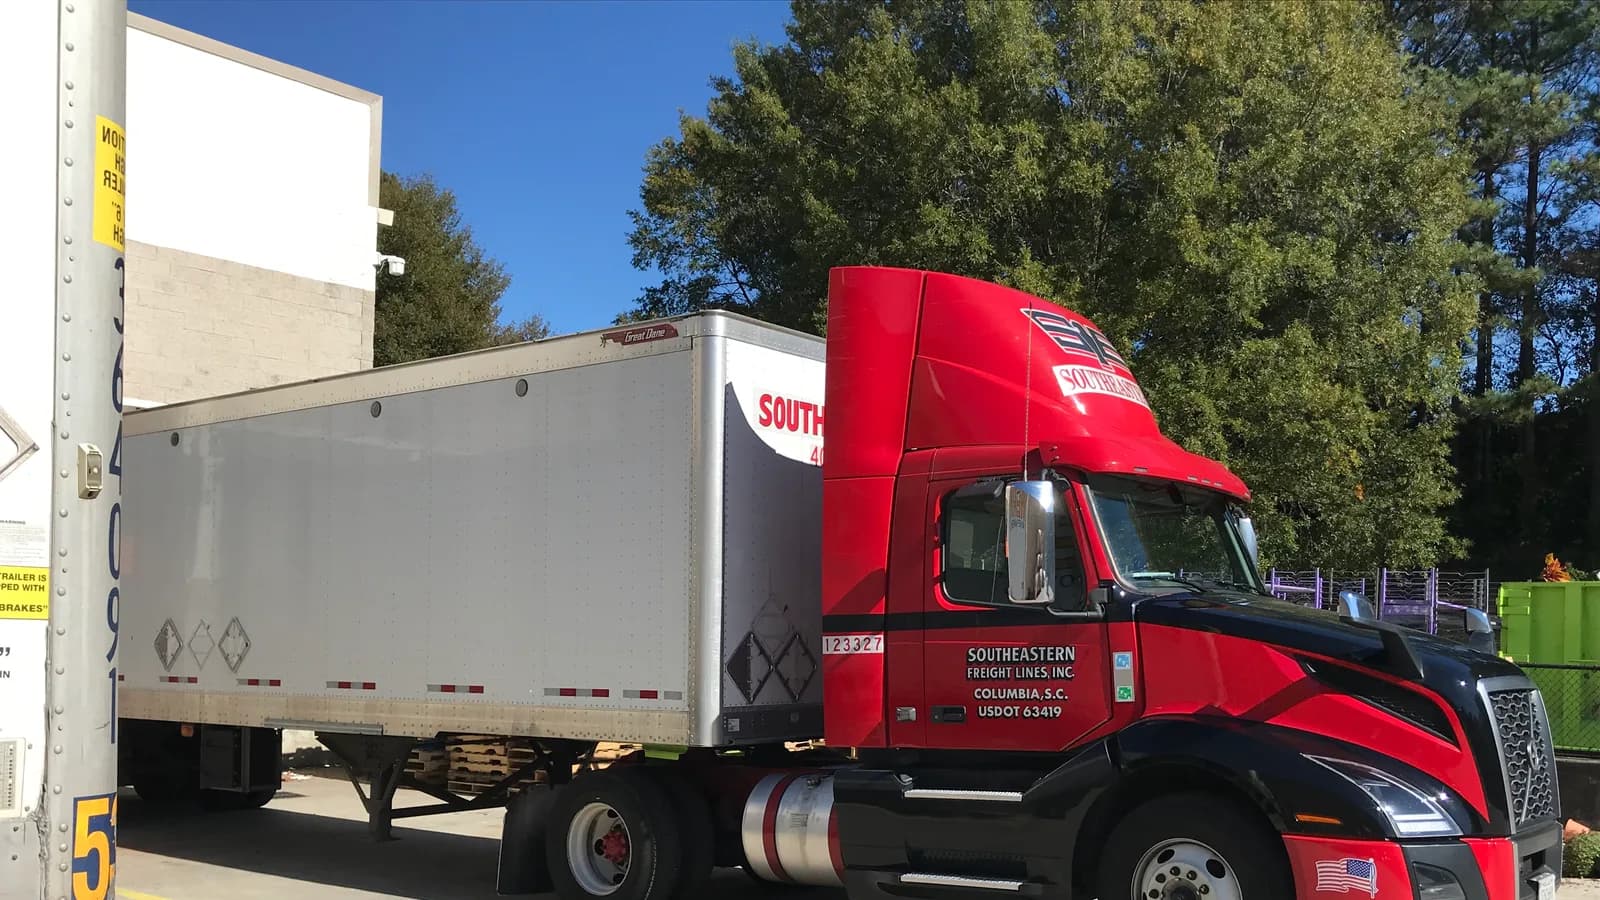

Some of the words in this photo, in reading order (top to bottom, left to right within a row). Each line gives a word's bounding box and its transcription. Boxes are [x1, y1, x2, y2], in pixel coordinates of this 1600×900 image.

[625, 331, 645, 343] Great
[645, 328, 666, 340] Dane
[38, 574, 47, 582] IS
[22, 584, 45, 592] WITH
[825, 637, 882, 652] 123327
[968, 646, 1076, 662] SOUTHEASTERN
[967, 667, 1012, 679] FREIGHT
[1015, 666, 1050, 679] LINES,
[1052, 666, 1075, 678] INC.
[978, 705, 1020, 717] USDOT
[1023, 705, 1062, 718] 63419
